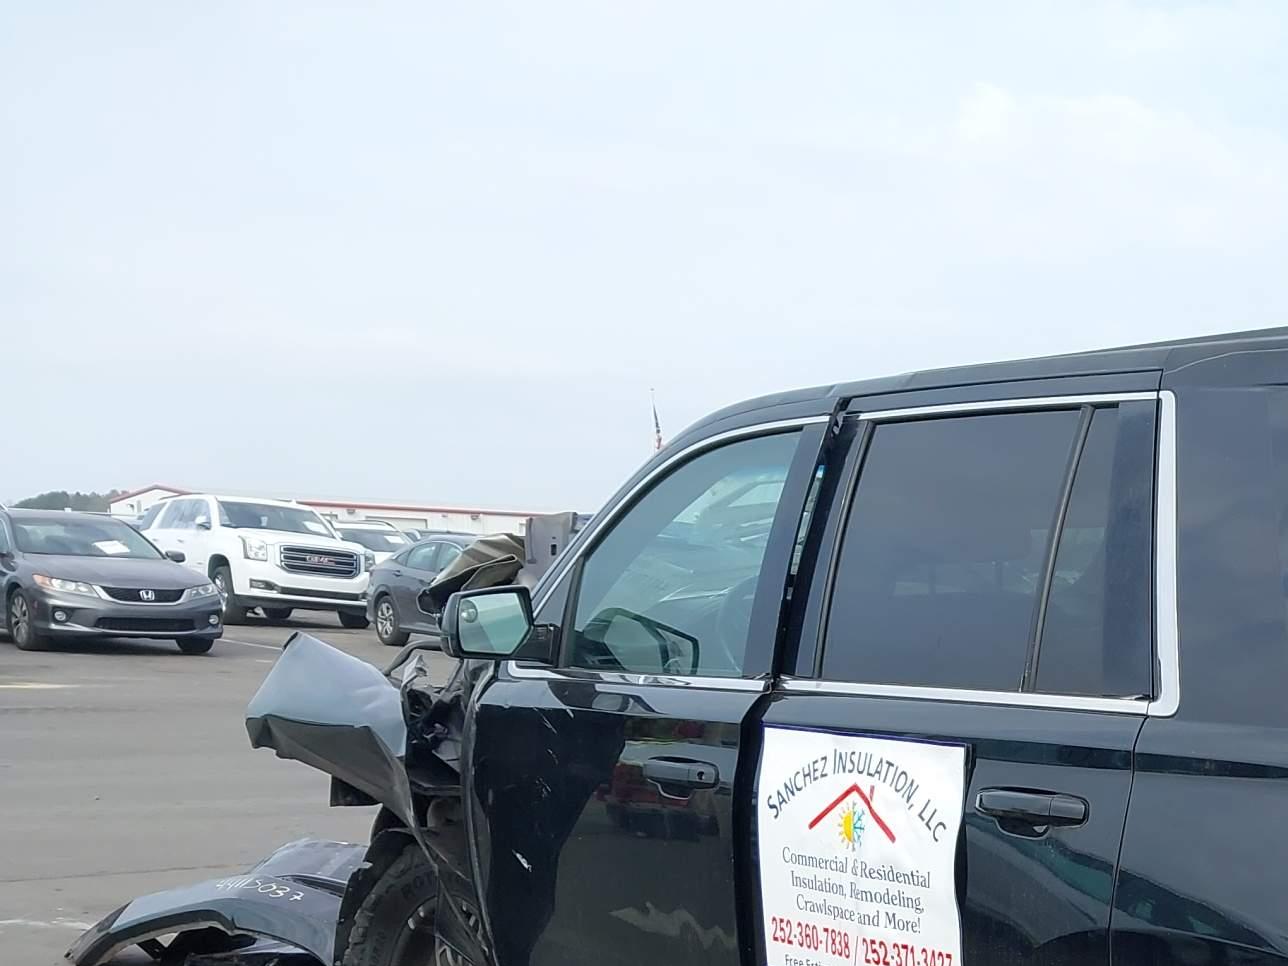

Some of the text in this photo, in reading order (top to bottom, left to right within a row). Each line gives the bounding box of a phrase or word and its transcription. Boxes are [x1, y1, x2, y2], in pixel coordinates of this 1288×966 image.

[766, 748, 947, 842] SANCHEZ INSULATION, LLC
[782, 846, 931, 889] Commercial & Residential
[791, 870, 925, 913] Insulation, Remodeling,
[796, 894, 921, 934] Crawlspace and More!
[771, 916, 851, 959] 252-360-7838
